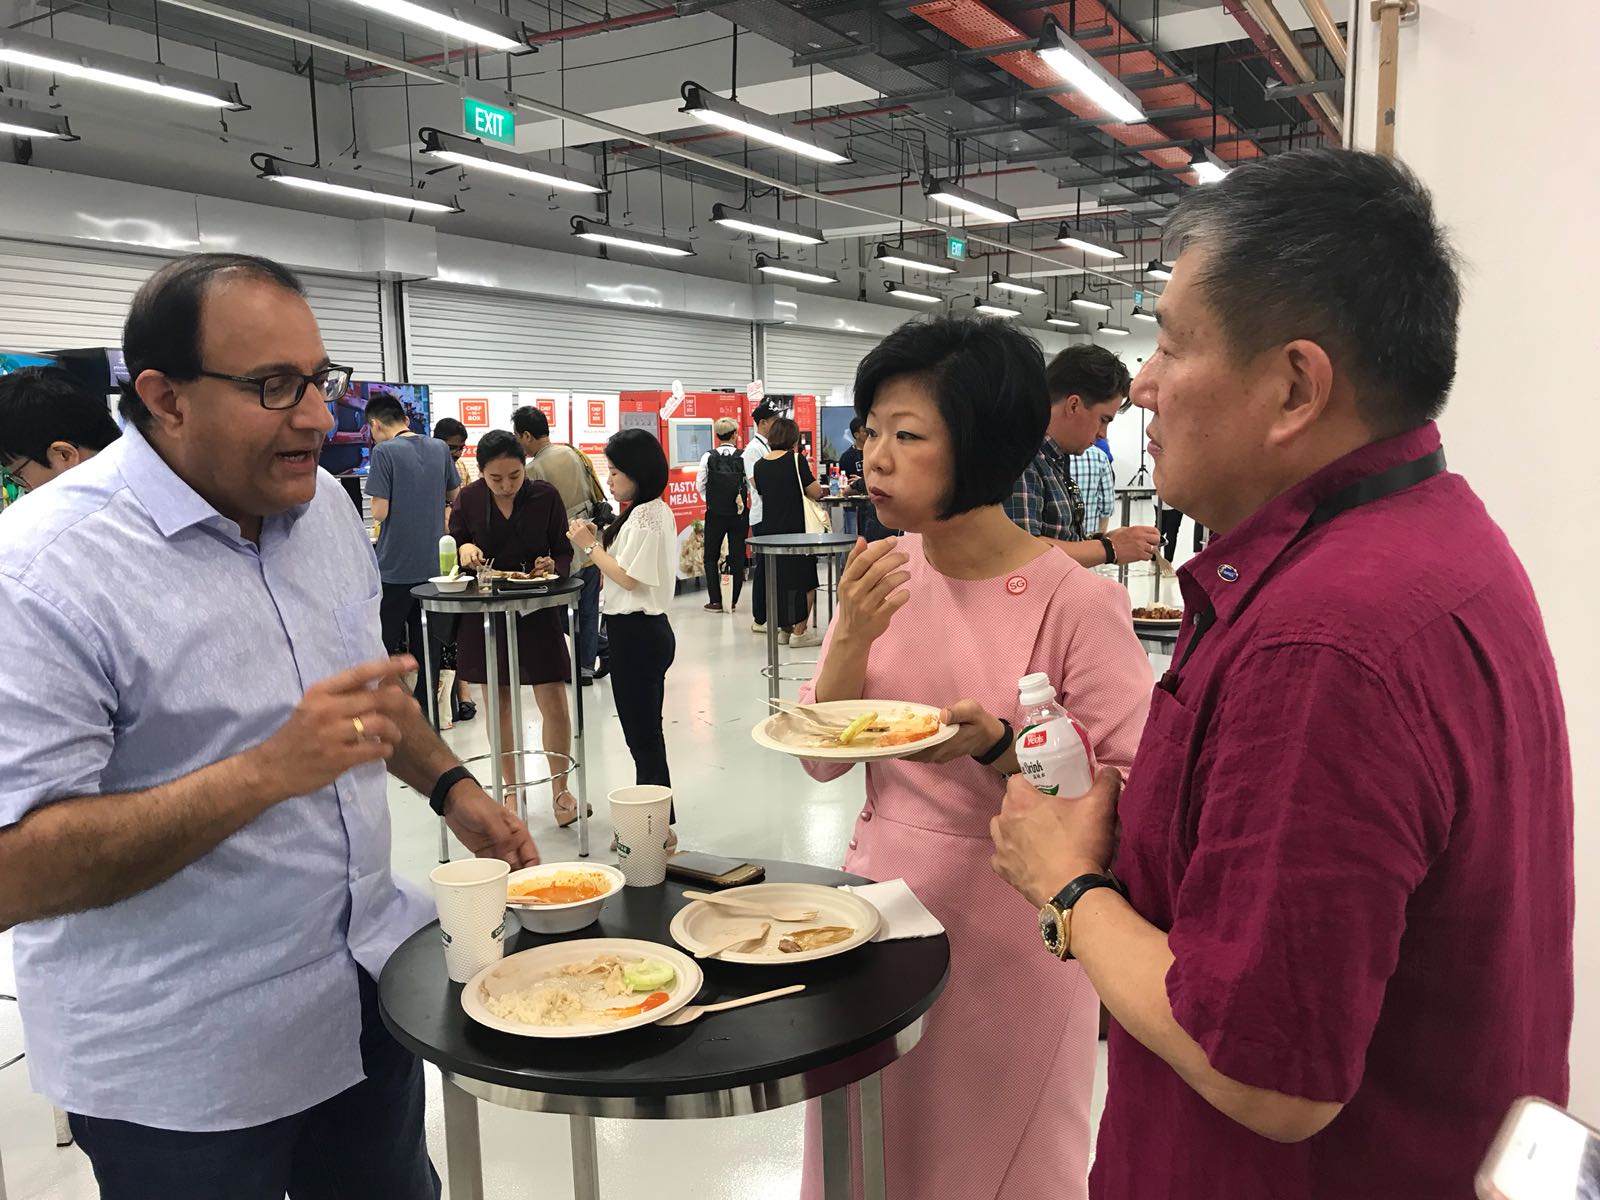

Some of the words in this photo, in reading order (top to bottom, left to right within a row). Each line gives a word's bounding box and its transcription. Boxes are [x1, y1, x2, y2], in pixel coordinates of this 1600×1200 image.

[475, 107, 504, 137] EXIT
[669, 481, 696, 493] TASTY
[669, 493, 698, 506] MEALS
[1009, 579, 1025, 590] SG
[1024, 760, 1044, 774] Drink
